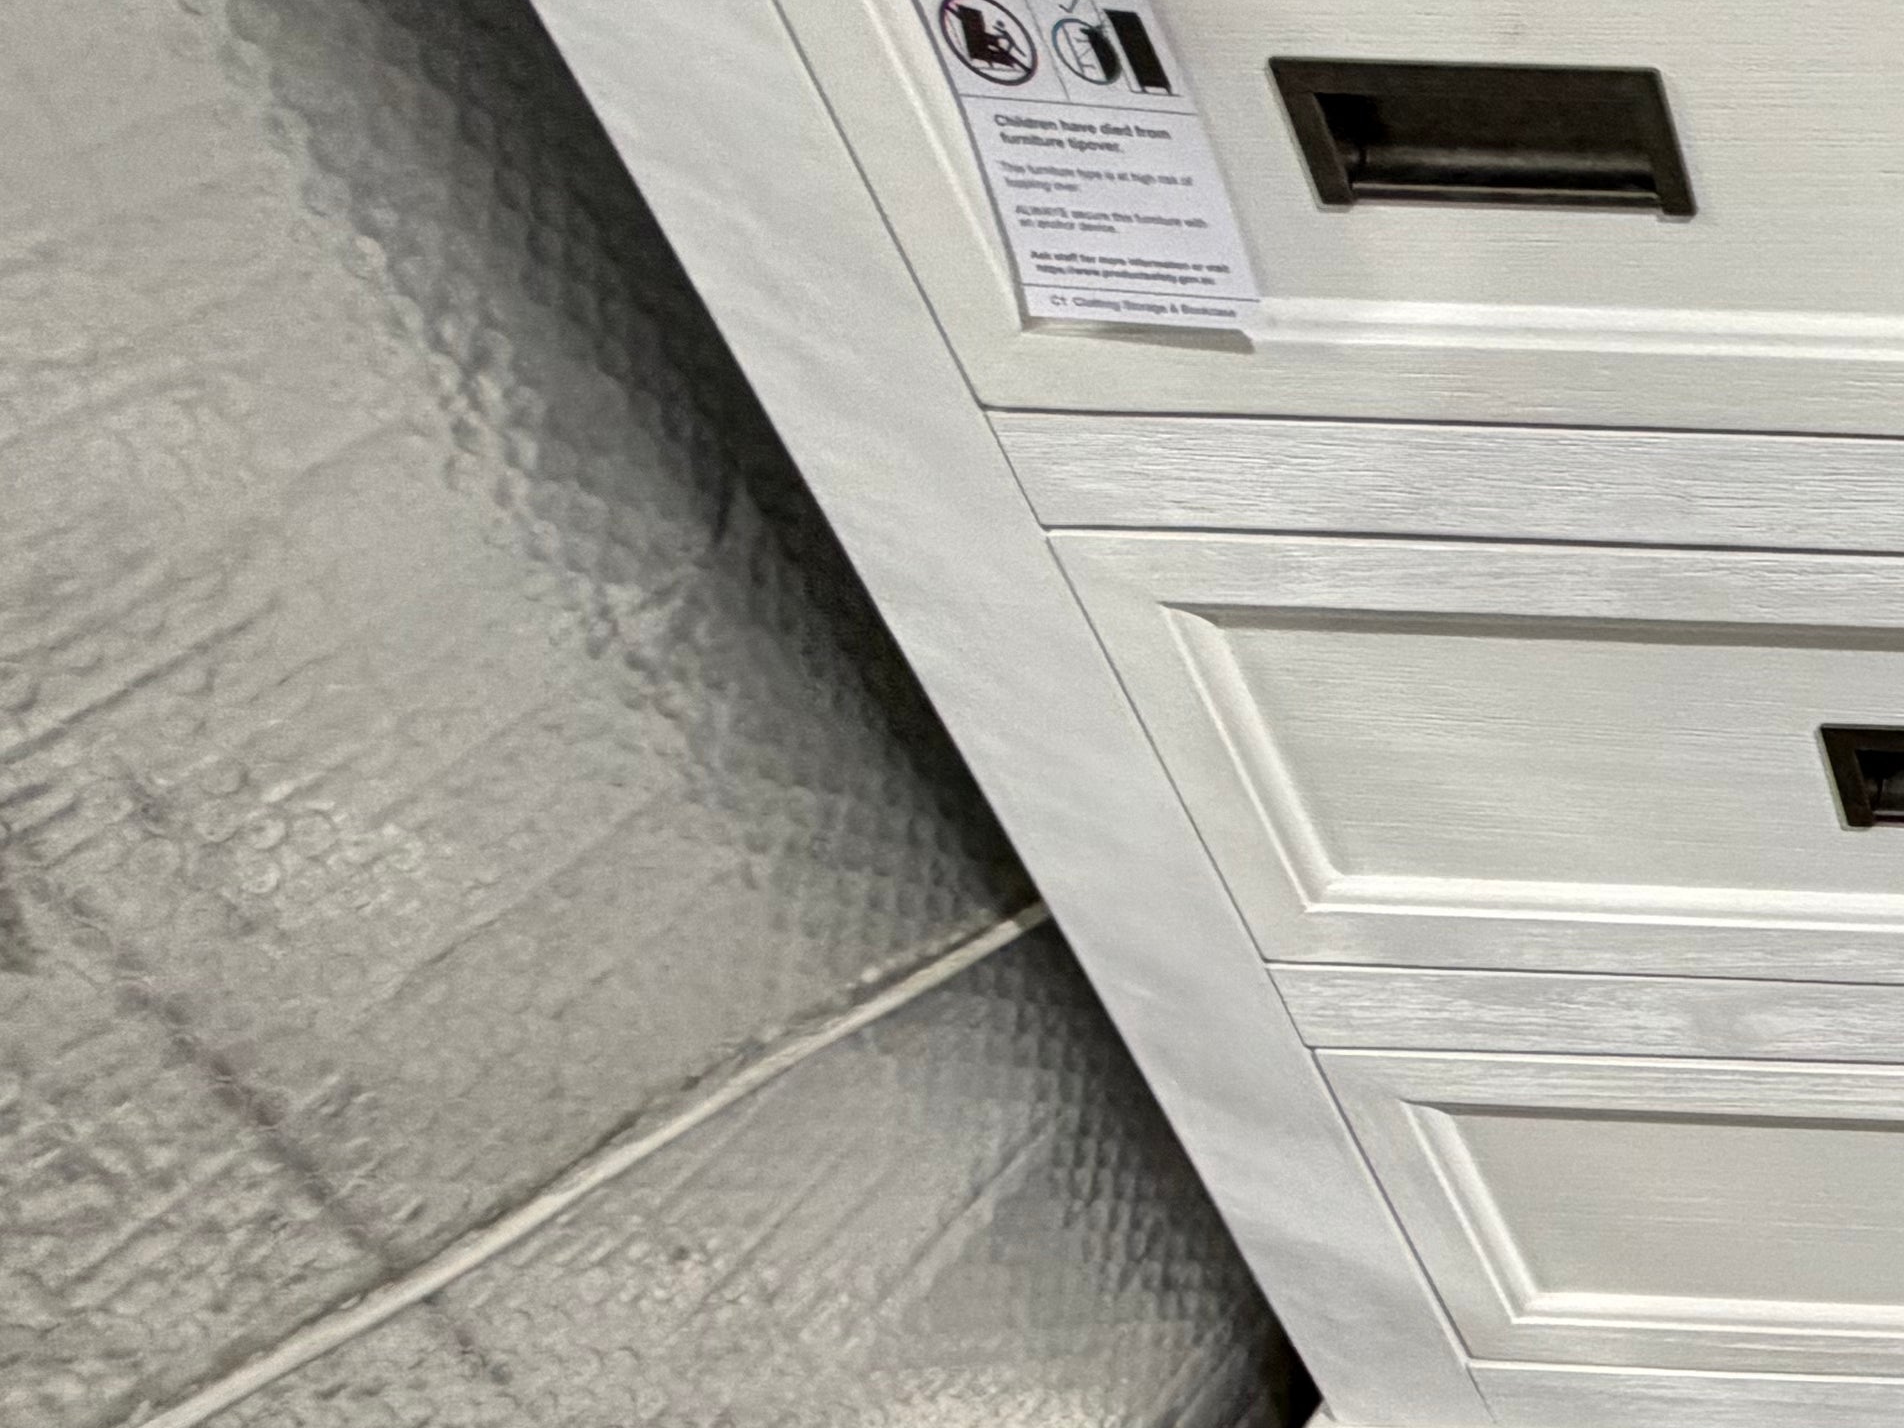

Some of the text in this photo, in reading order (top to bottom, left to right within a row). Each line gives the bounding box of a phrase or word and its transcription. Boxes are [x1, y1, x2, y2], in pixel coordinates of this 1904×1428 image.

[994, 114, 1172, 139] Children have died from
[1000, 132, 1065, 148] furniture
